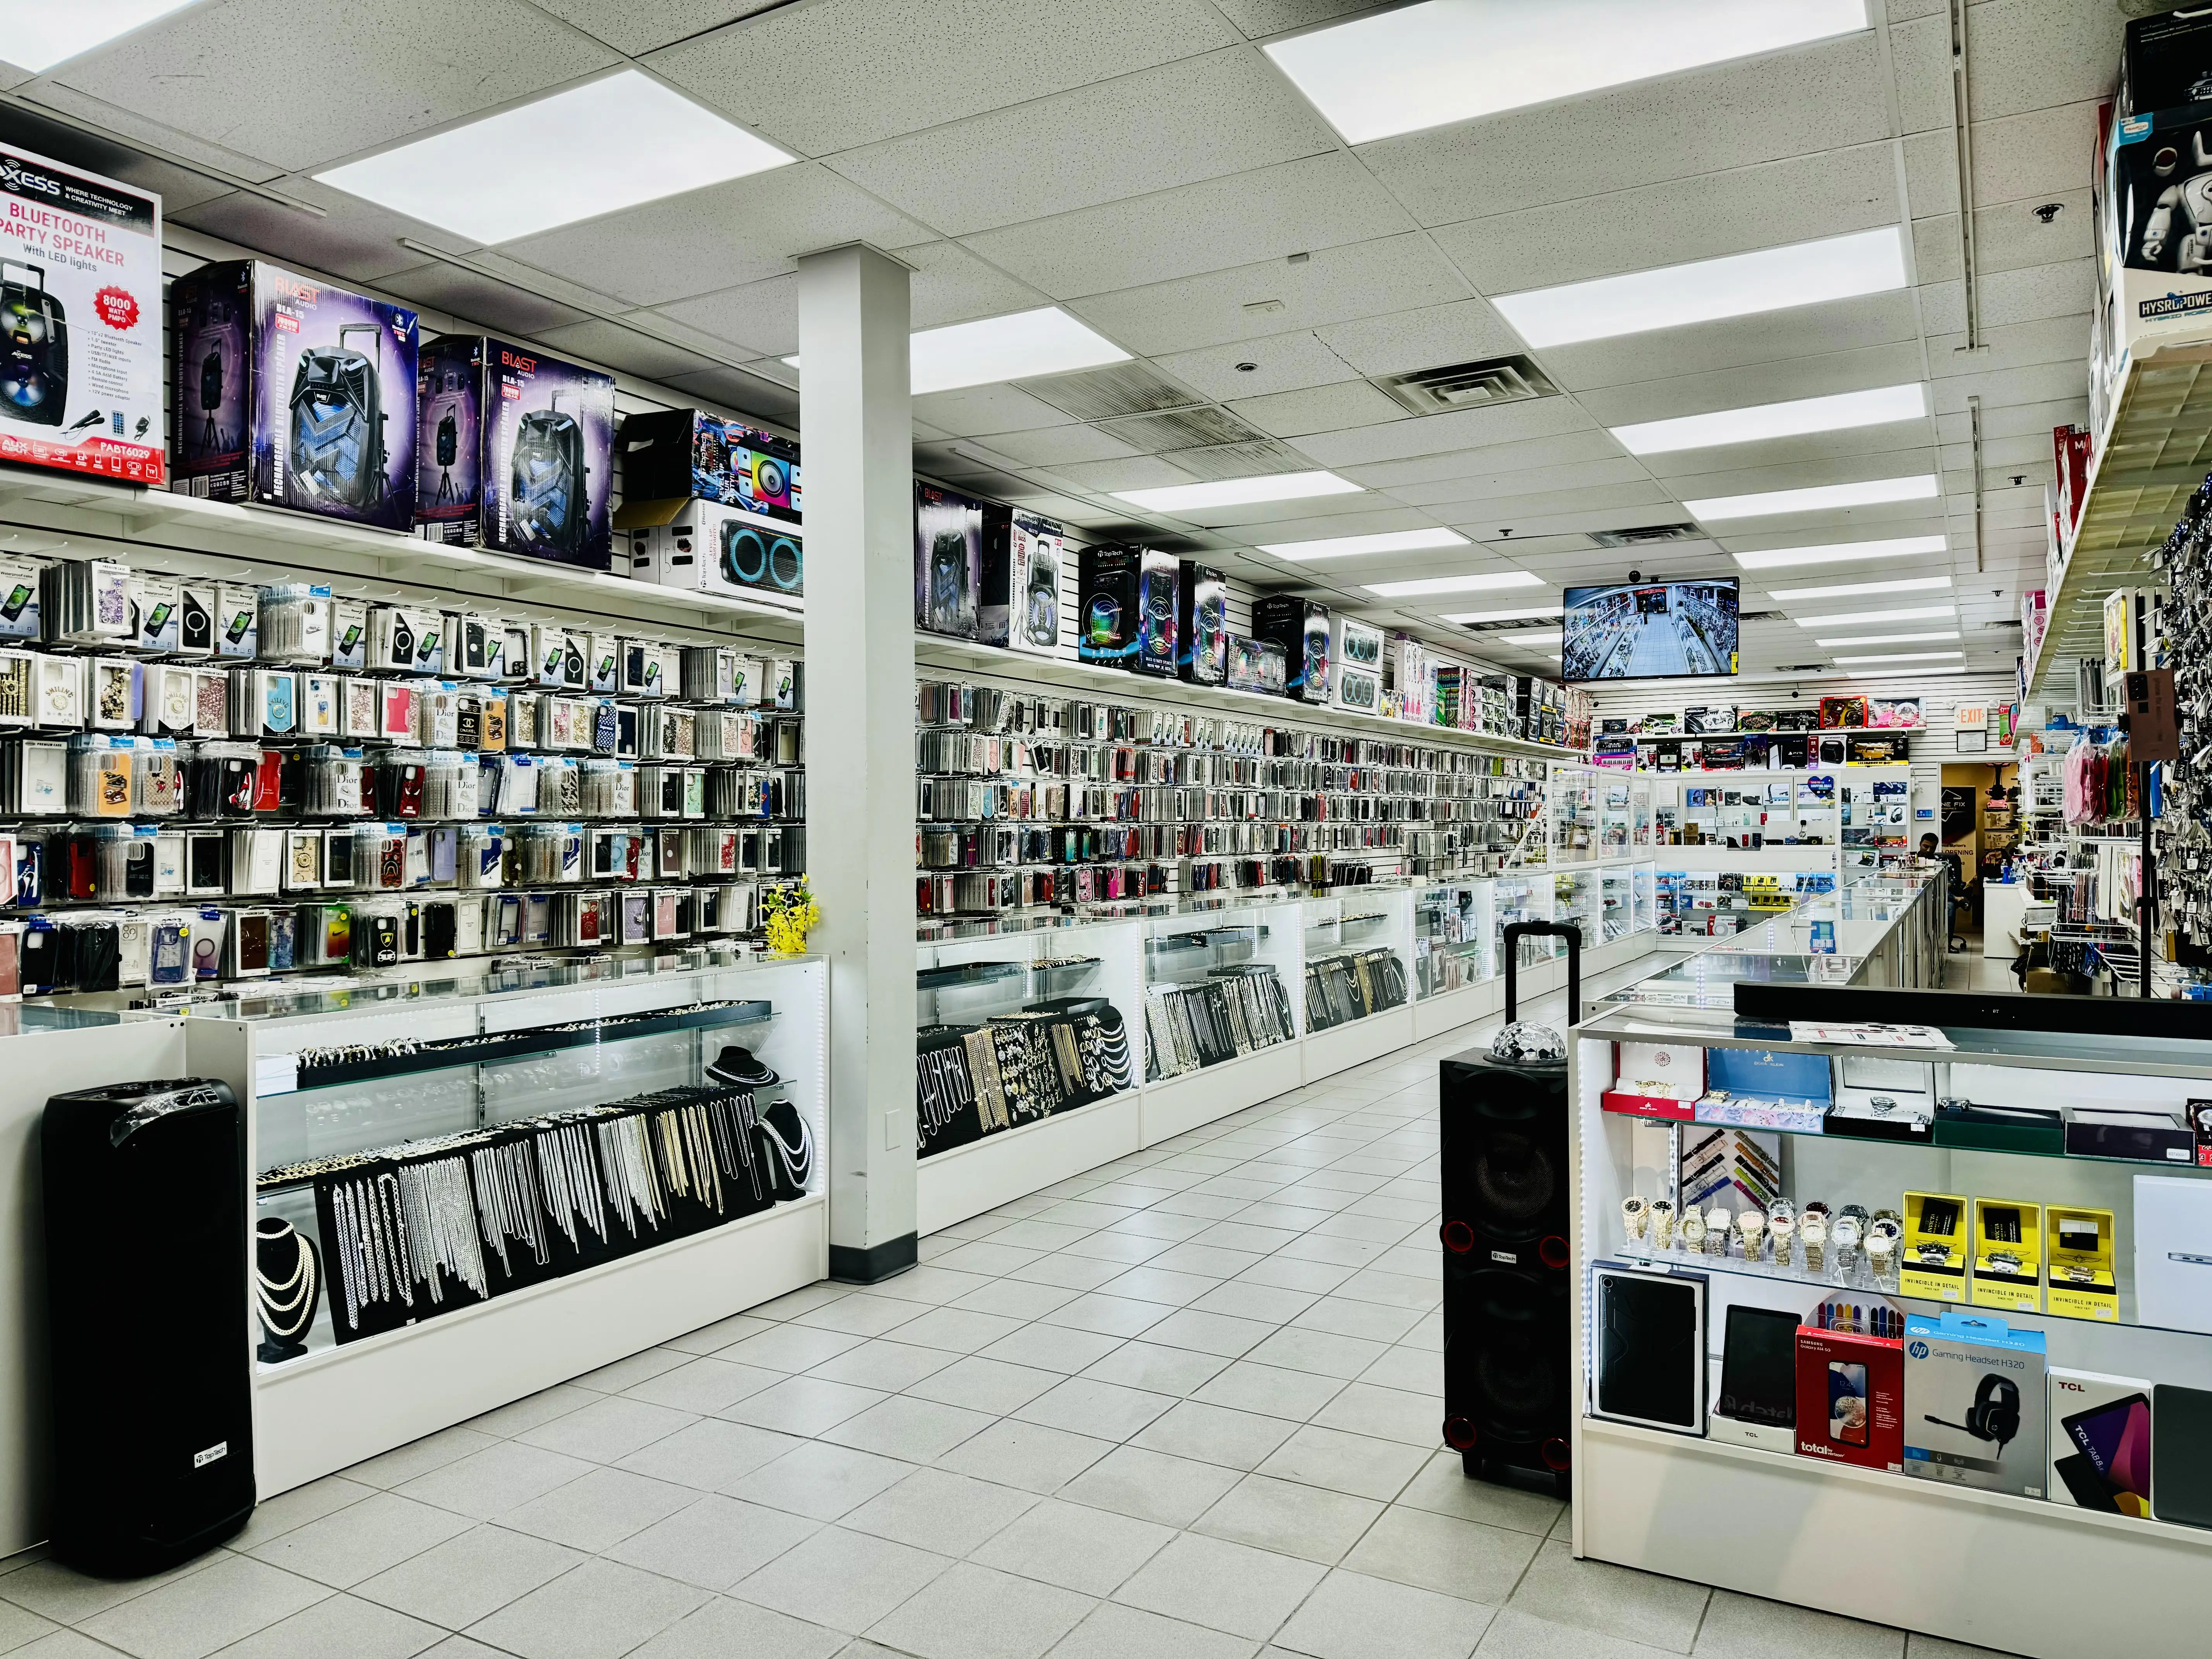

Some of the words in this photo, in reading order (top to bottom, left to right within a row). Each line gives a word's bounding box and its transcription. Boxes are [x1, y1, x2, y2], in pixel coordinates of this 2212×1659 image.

[65, 186, 89, 198] WHERE
[90, 194, 133, 211] TECHNOLOGY
[71, 196, 108, 211] CREATIVITY
[108, 208, 126, 216] MEET
[10, 202, 105, 243] BLUETOOTH
[0, 218, 47, 244] PARTY
[53, 235, 124, 267] SPEAKER
[23, 243, 45, 258] With
[48, 251, 66, 263] LED
[70, 256, 97, 272] lights
[275, 276, 320, 304] BLAST
[103, 295, 130, 310] 8000
[295, 299, 317, 310] AUDIO
[108, 307, 125, 316] WATT
[276, 303, 304, 319] BLA-15
[108, 314, 126, 323] PMPO
[12, 350, 32, 359] AXESS
[502, 351, 537, 373] BLAST
[517, 370, 535, 379] AUDIO
[503, 375, 524, 387] BLA-15
[275, 375, 285, 426] BLUETOOTH
[2, 440, 27, 449] AUX
[2, 445, 27, 455] INPUT
[100, 442, 150, 459] PABT6029
[273, 428, 284, 496] RECHARGEABLE
[500, 436, 508, 481] BLUETOOTH
[925, 488, 942, 502] BLAST
[499, 484, 507, 542] RECHARGEABLE
[45, 686, 74, 698] SMILING
[437, 708, 455, 717] Dior
[1961, 708, 1982, 723] EXIT
[436, 730, 454, 741] Dior
[337, 774, 357, 784] Dior
[458, 781, 476, 789] Dior
[616, 781, 629, 791] Dior
[338, 798, 357, 809] Dior
[457, 803, 475, 813] Dior
[1905, 1278, 1933, 1287] INVINCIBLE
[1977, 1287, 2006, 1297] INVINCIBLE
[2053, 1297, 2084, 1305] INVINCIBLE
[1934, 1331, 1964, 1339] Gaming
[1910, 1341, 1929, 1359] hp
[1932, 1349, 1963, 1362] Gaming
[1965, 1354, 1999, 1366] Headset
[2001, 1359, 2025, 1370] H320
[2059, 1382, 2085, 1392] TCL
[2075, 1425, 2089, 1446] TCL
[204, 1448, 225, 1460] TopTech
[1801, 1441, 1827, 1455] total
